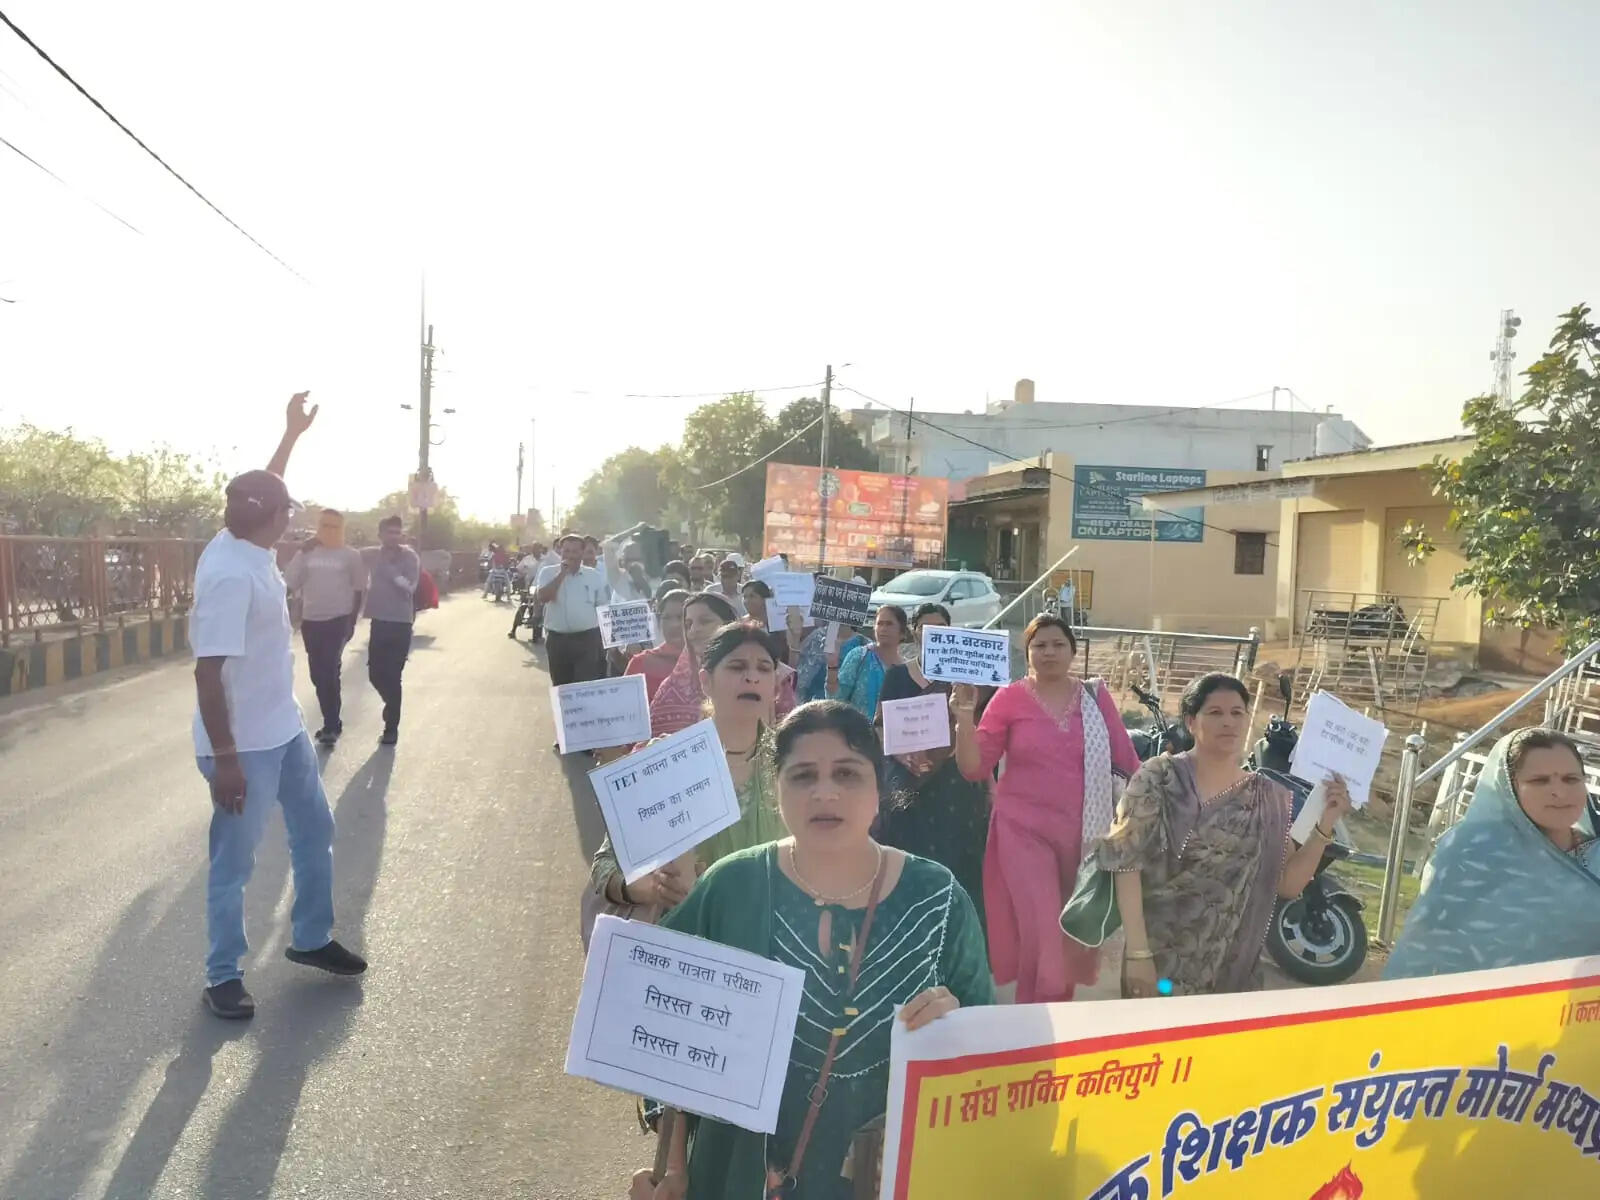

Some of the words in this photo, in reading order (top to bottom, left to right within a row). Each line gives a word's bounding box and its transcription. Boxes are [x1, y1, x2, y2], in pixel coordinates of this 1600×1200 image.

[1115, 471, 1158, 482] Starline
[1159, 473, 1202, 486] Laptops
[1077, 526, 1097, 535] ON
[930, 633, 959, 645] म.प्र.
[961, 637, 1004, 651] सरकार
[611, 770, 638, 791] TET
[637, 799, 666, 822] शिक्षक
[668, 792, 682, 805] का
[684, 777, 712, 798] सम्मान
[678, 962, 716, 983] पात्रता
[645, 984, 693, 1017] निरस्त
[700, 1004, 733, 1028] करो
[631, 1025, 680, 1057] निरस्त
[959, 1079, 1001, 1124] संघ
[1007, 1070, 1074, 1113] शक्ति
[1076, 1052, 1164, 1100] कलियुगे
[1161, 1110, 1325, 1199] शिक्षक
[1326, 1050, 1462, 1149] संयुक्त
[1456, 1043, 1557, 1123] मोर्चा
